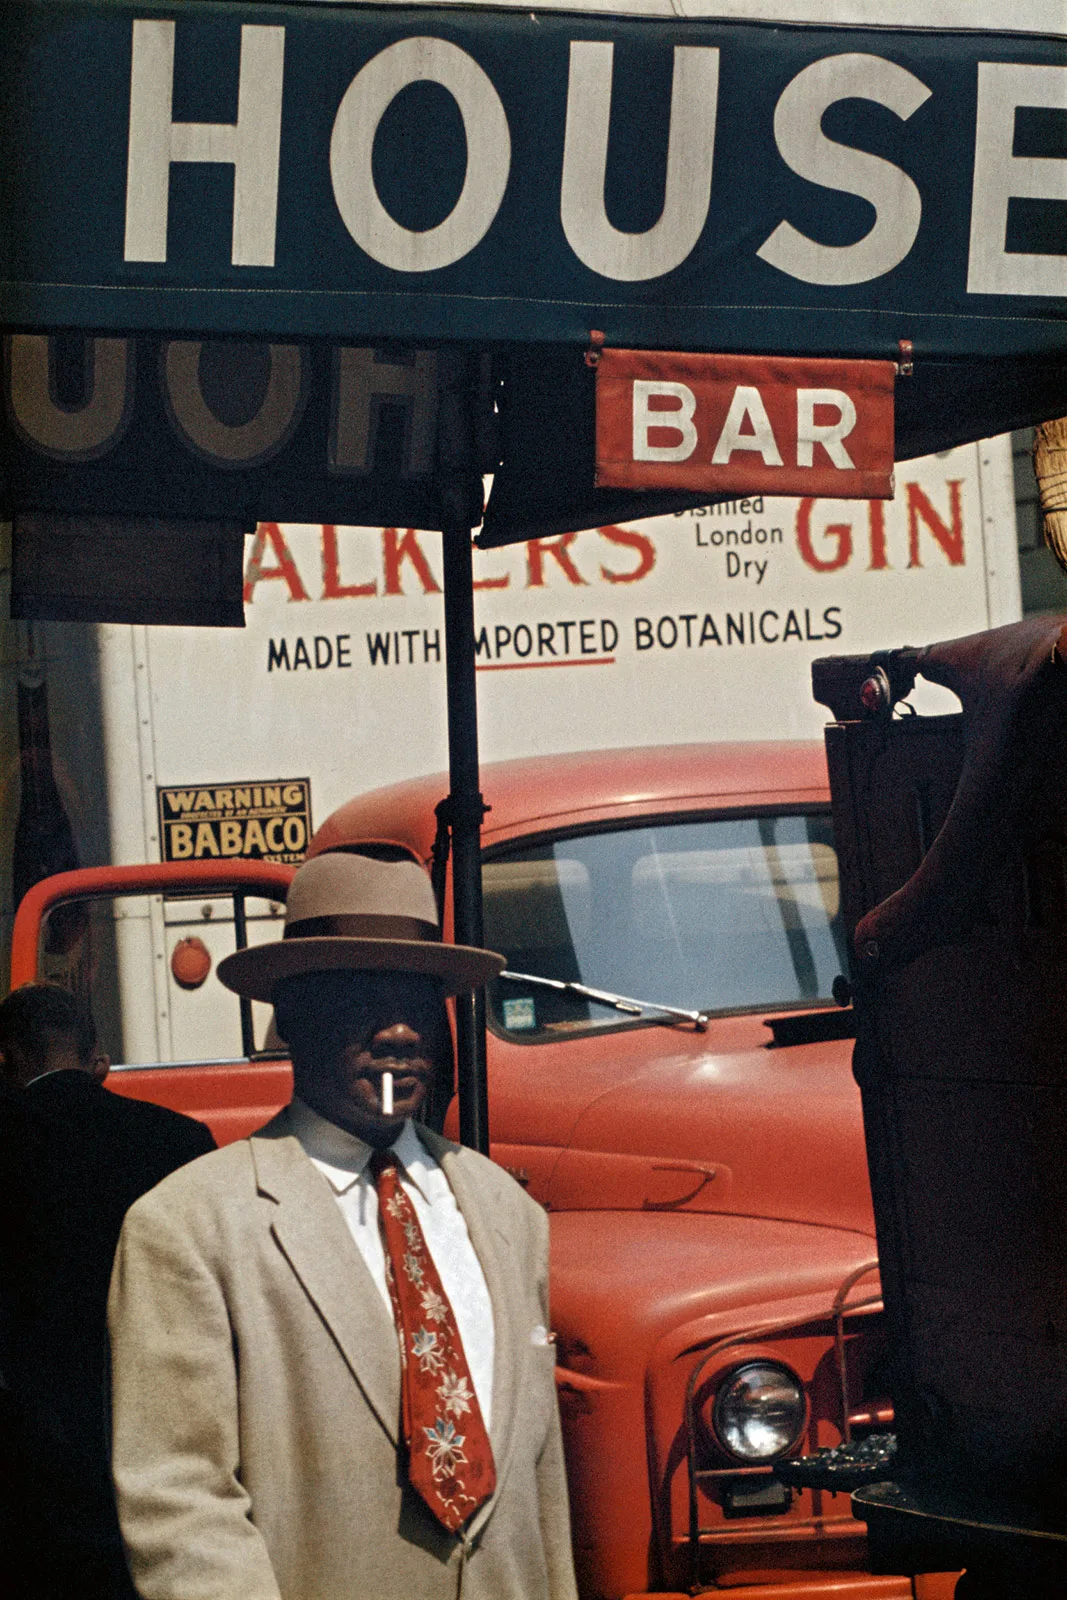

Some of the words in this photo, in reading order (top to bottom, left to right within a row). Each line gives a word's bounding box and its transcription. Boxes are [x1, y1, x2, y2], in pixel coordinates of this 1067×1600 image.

[124, 20, 1067, 296] HOUSE
[632, 379, 857, 470] BAR
[696, 519, 783, 547] London
[795, 479, 965, 573] GIN
[726, 551, 768, 585] Dry
[267, 635, 352, 673] MADE
[366, 629, 441, 665] WITH
[474, 619, 618, 660] MPORTED
[635, 607, 843, 651] BOTANICALS
[166, 784, 303, 812] WARNING
[171, 816, 306, 859] BABACO
